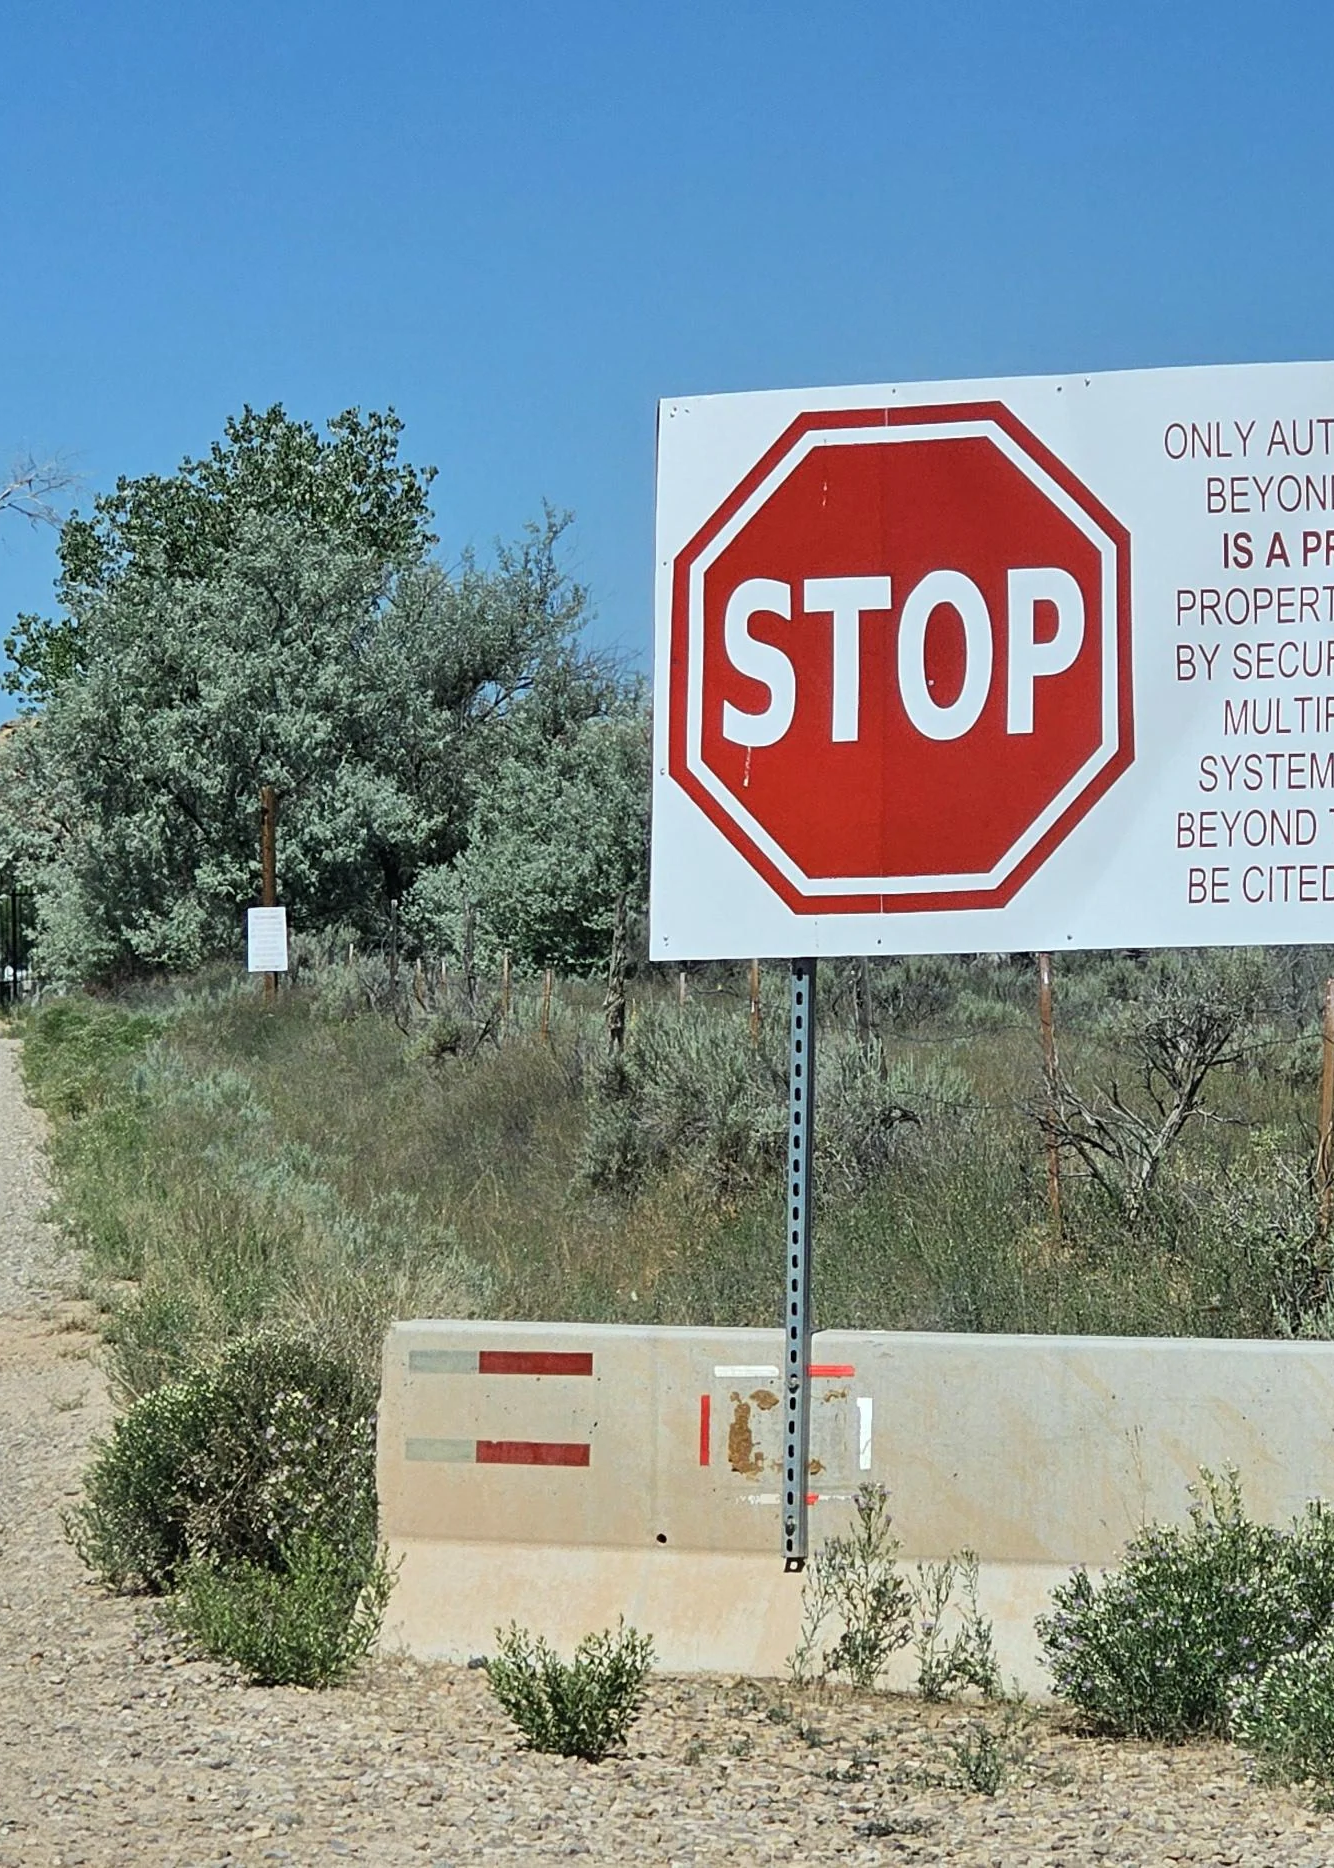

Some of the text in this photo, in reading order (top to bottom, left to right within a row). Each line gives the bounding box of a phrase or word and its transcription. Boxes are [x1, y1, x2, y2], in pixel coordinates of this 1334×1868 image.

[1165, 420, 1256, 459] ONLY
[1224, 532, 1253, 569] IS
[1265, 532, 1290, 568] A
[723, 568, 1084, 747] STOP
[1177, 644, 1220, 681] BY
[1177, 809, 1316, 848] BEYOND
[1189, 867, 1230, 904] BE
